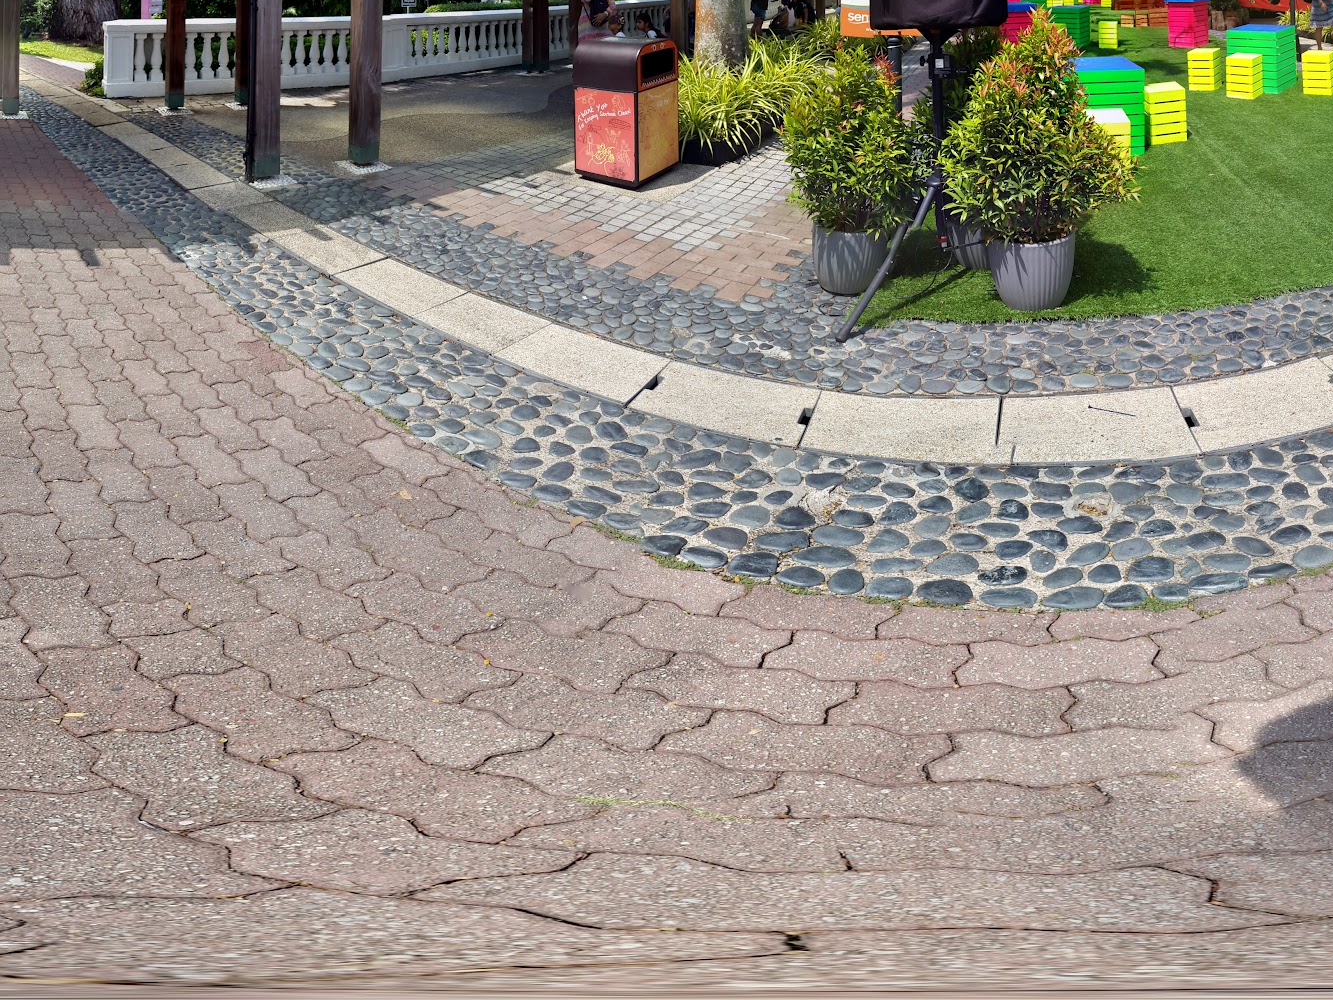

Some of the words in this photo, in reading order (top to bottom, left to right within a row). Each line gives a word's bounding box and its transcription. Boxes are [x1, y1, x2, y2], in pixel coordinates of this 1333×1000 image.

[847, 12, 870, 22] sen
[577, 105, 595, 123] Thank
[596, 102, 609, 112] You
